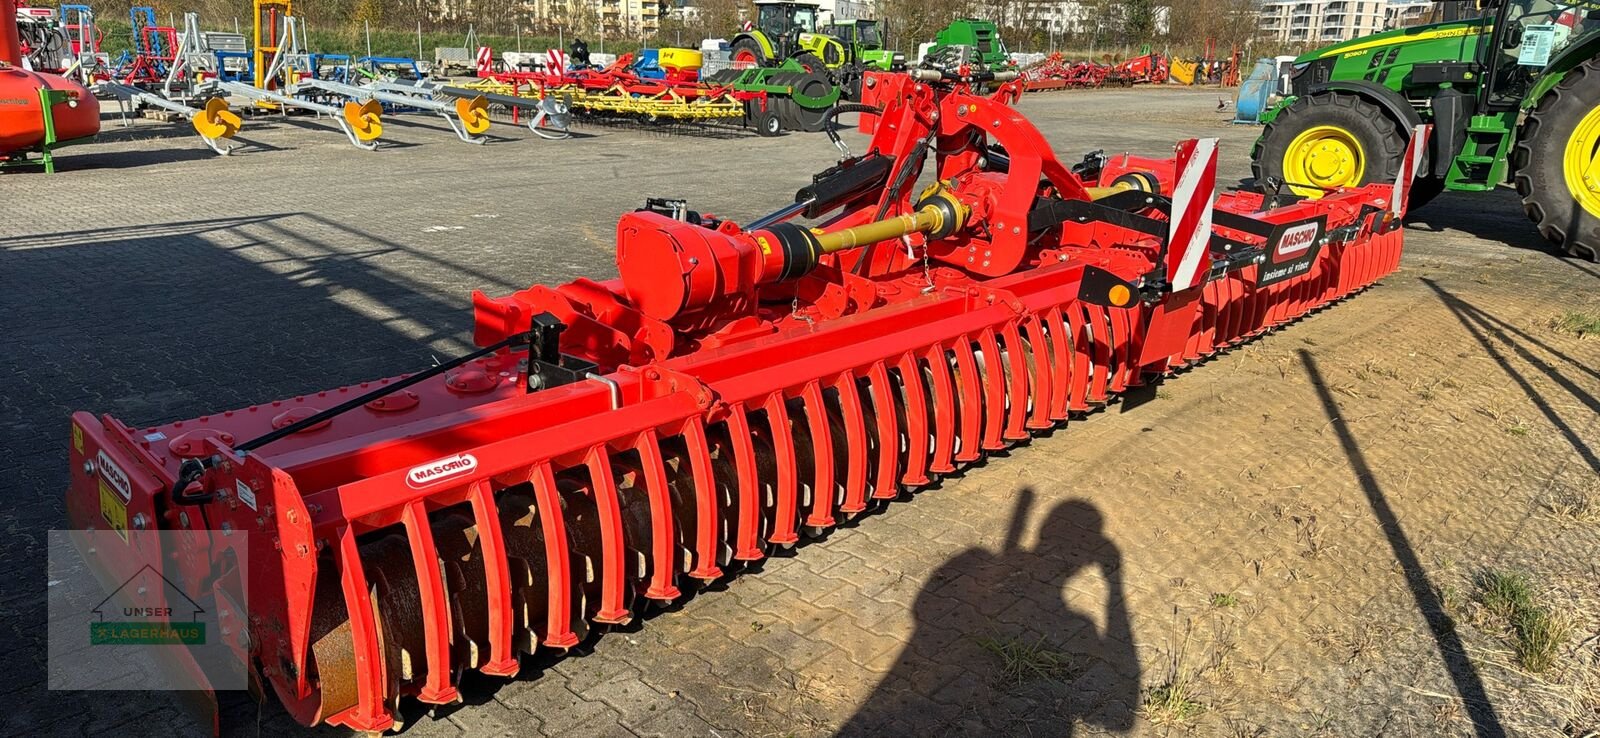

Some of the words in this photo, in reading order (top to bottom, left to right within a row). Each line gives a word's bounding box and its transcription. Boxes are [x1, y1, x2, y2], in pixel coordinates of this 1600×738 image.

[1434, 30, 1456, 38] JOHN
[1281, 228, 1316, 249] MASCHIO
[1263, 268, 1287, 281] insieme
[1287, 263, 1295, 274] si
[1295, 261, 1310, 272] vince
[100, 455, 129, 494] MASCHIO
[415, 459, 471, 479] MASCHIO
